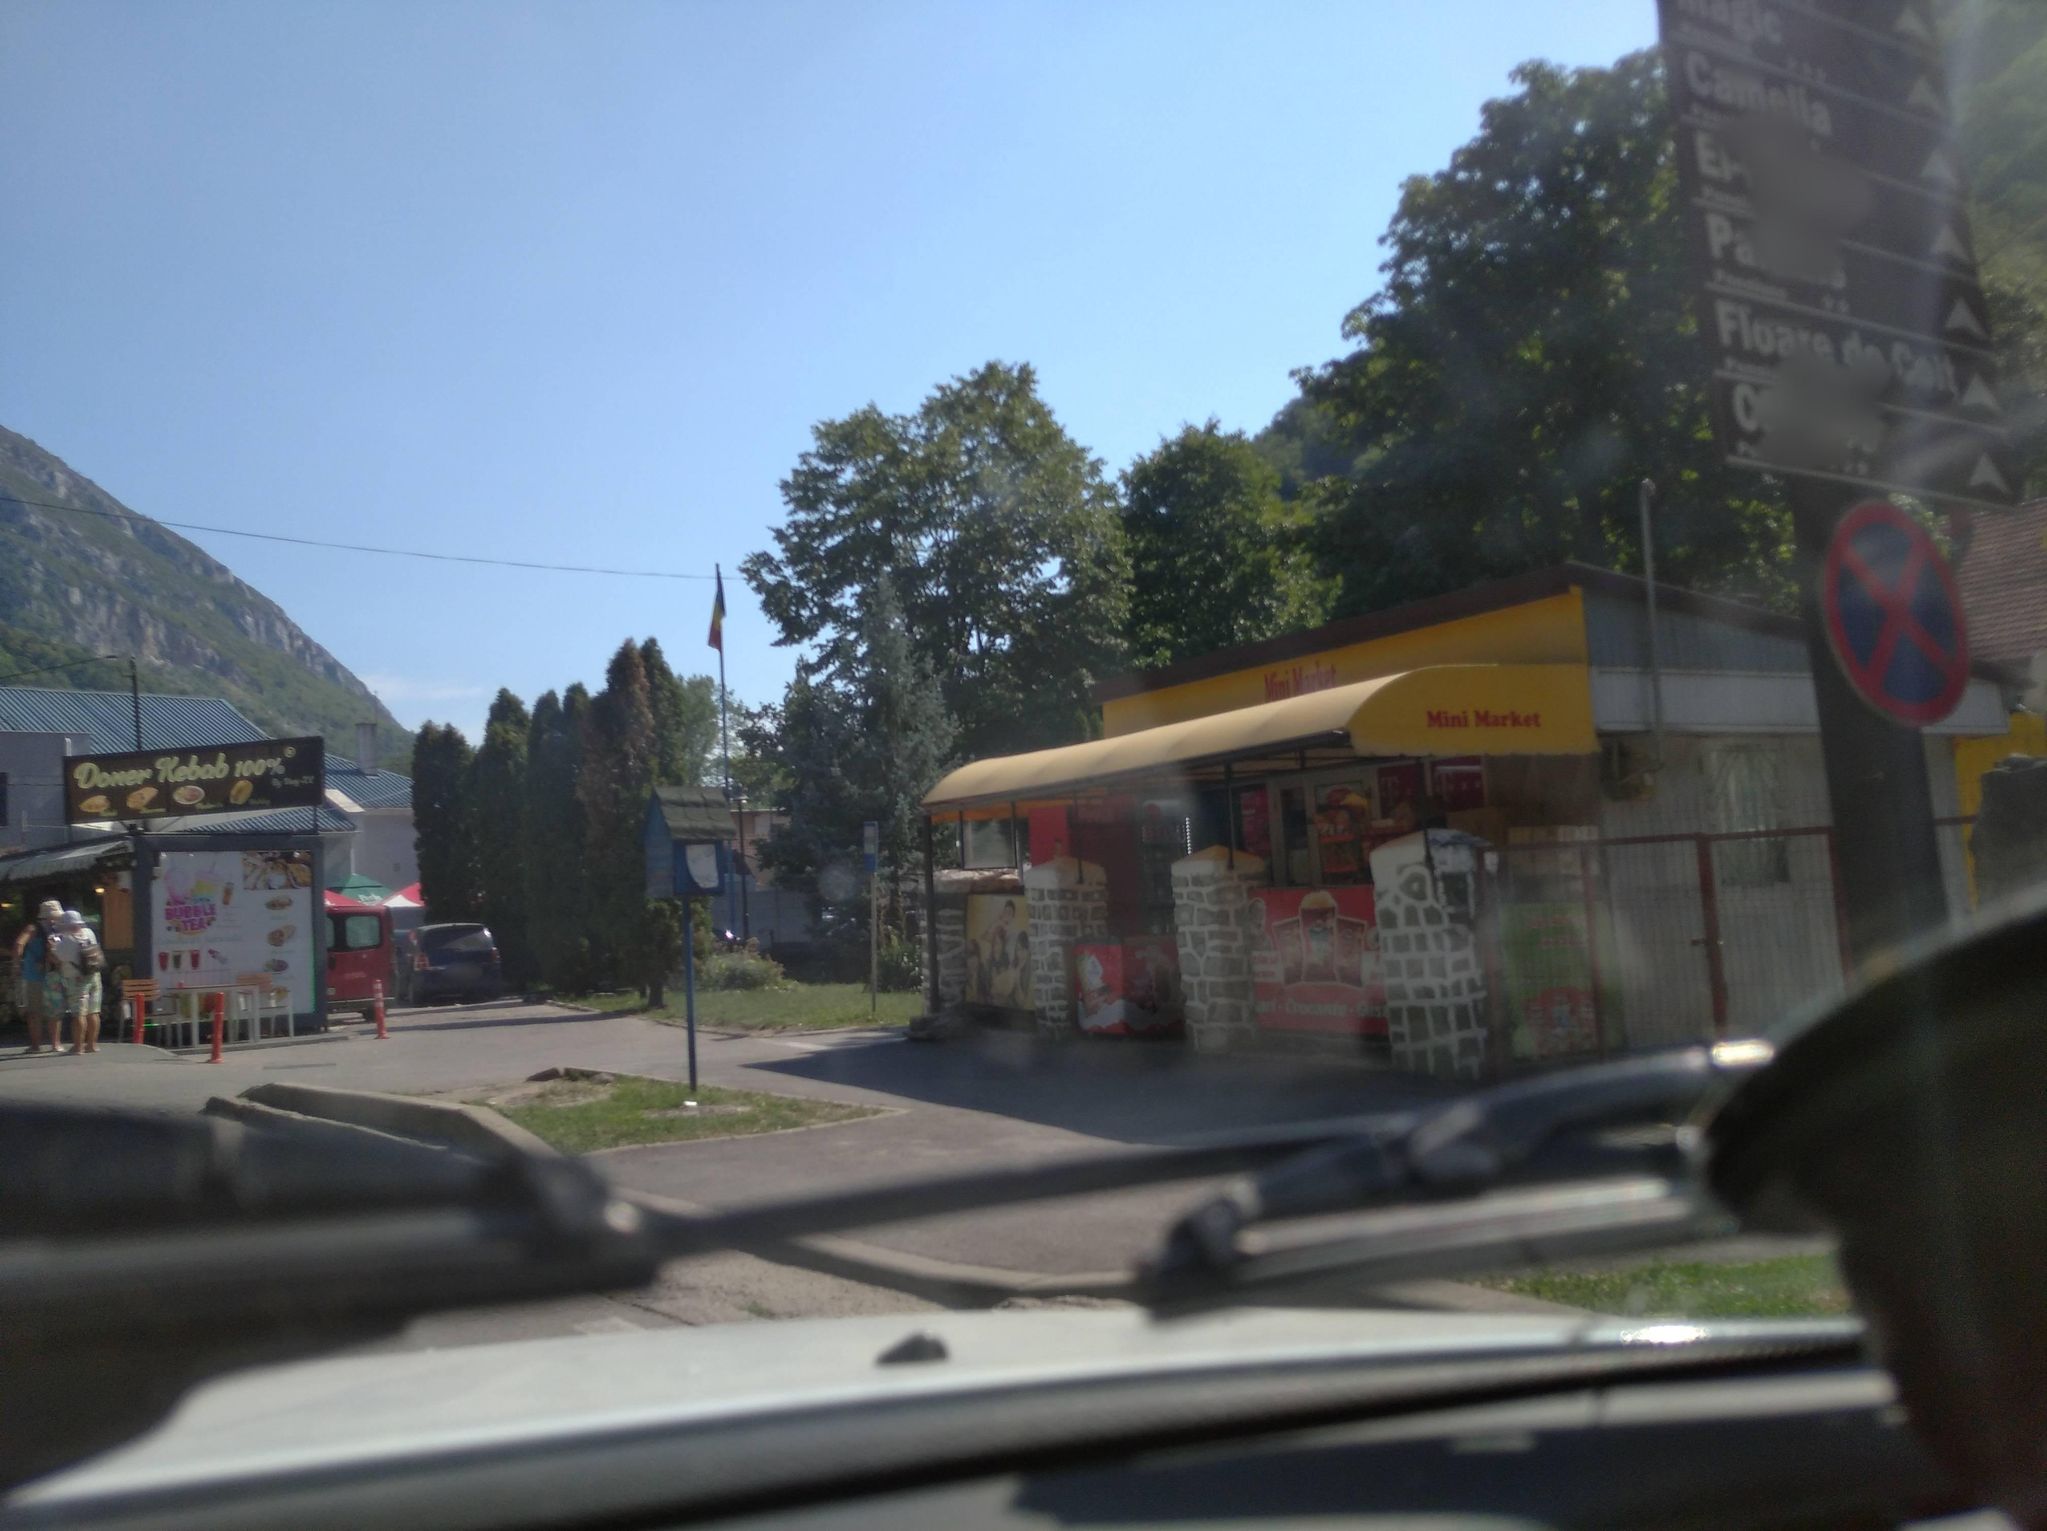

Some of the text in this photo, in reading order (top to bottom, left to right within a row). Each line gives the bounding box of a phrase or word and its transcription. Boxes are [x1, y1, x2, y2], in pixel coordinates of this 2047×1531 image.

[1427, 711, 1541, 728] Mini Market
[156, 753, 229, 782] Kebab
[234, 757, 285, 777] 100%
